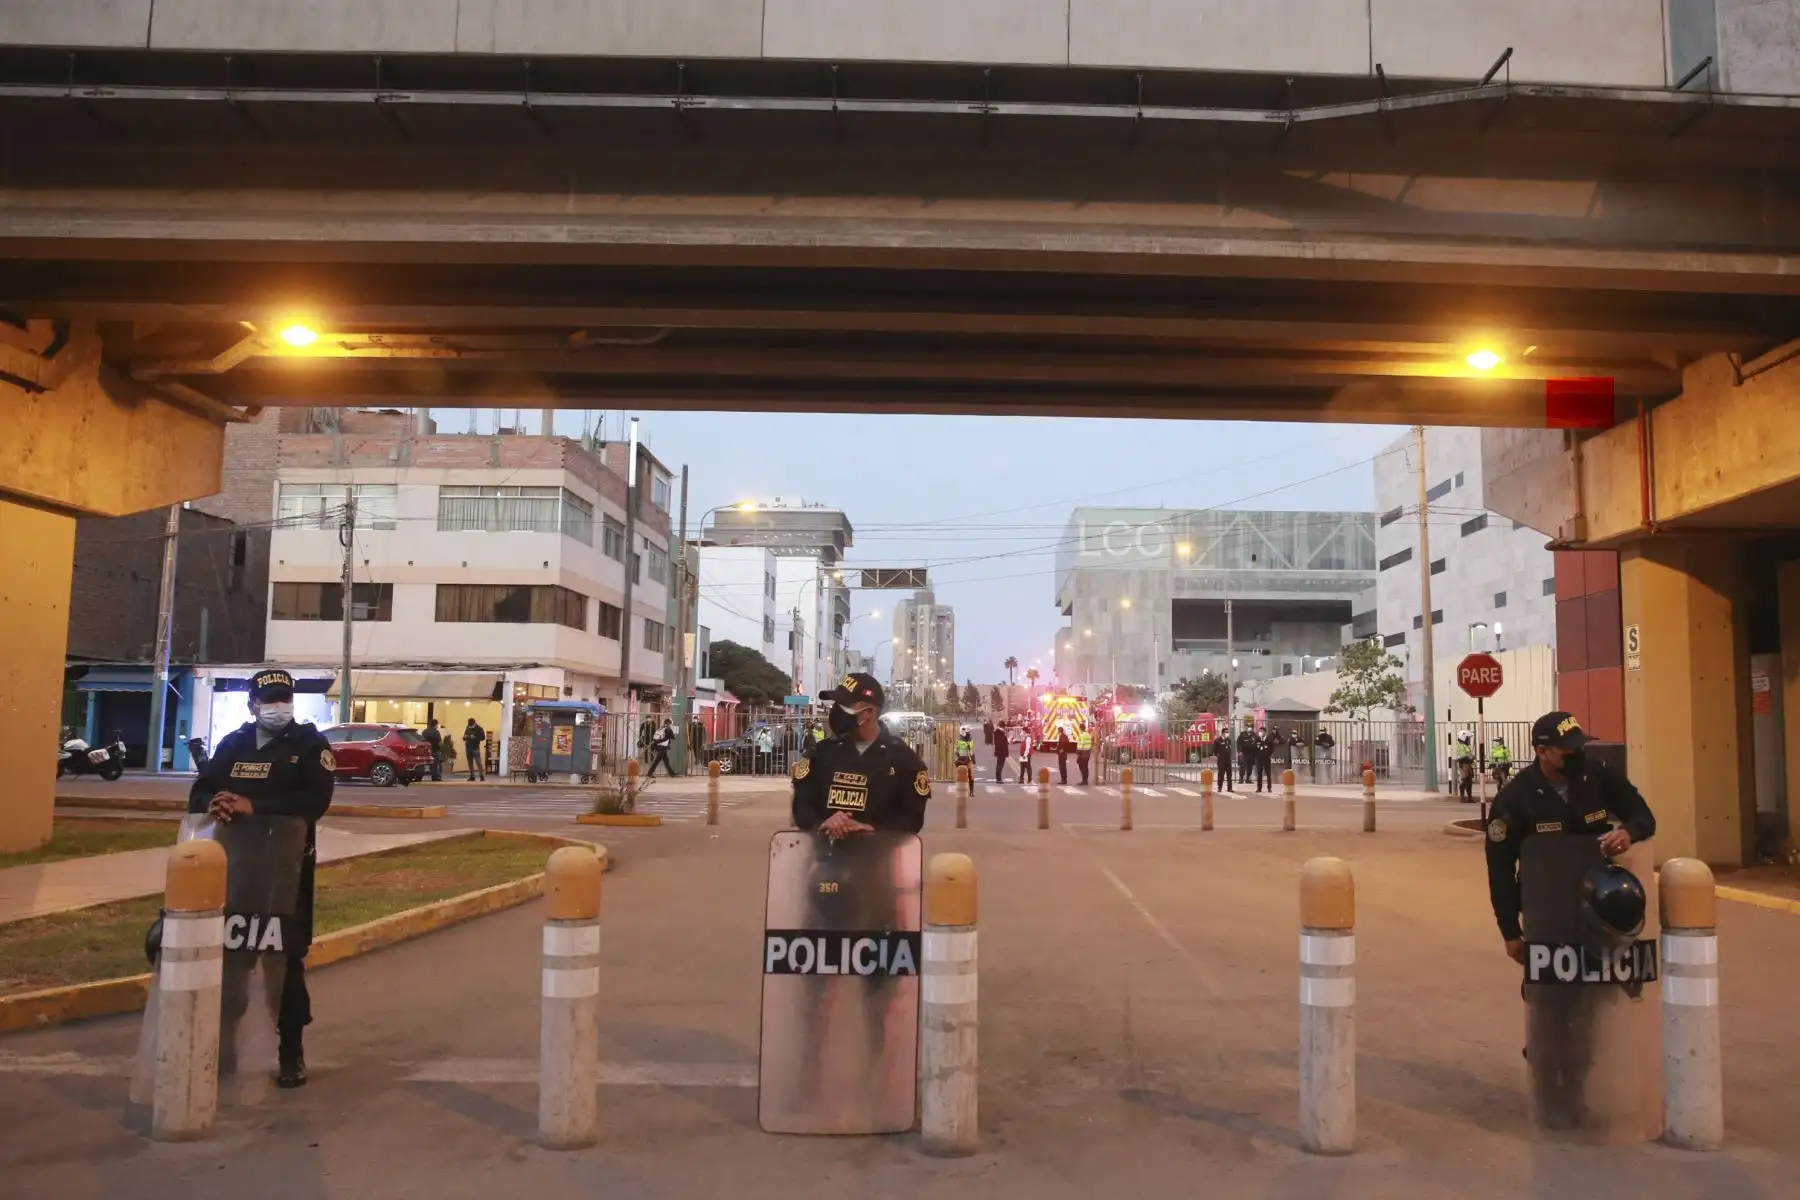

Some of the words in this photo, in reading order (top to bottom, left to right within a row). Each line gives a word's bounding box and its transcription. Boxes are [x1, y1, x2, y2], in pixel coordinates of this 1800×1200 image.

[1080, 520, 1165, 556] LCC
[1629, 628, 1638, 651] S
[257, 673, 291, 689] POLICIA
[1461, 667, 1500, 684] PARE
[829, 789, 865, 807] POLICIA
[224, 913, 283, 951] CIA
[766, 936, 917, 976] POLICIA
[1529, 943, 1657, 982] POLICIA
